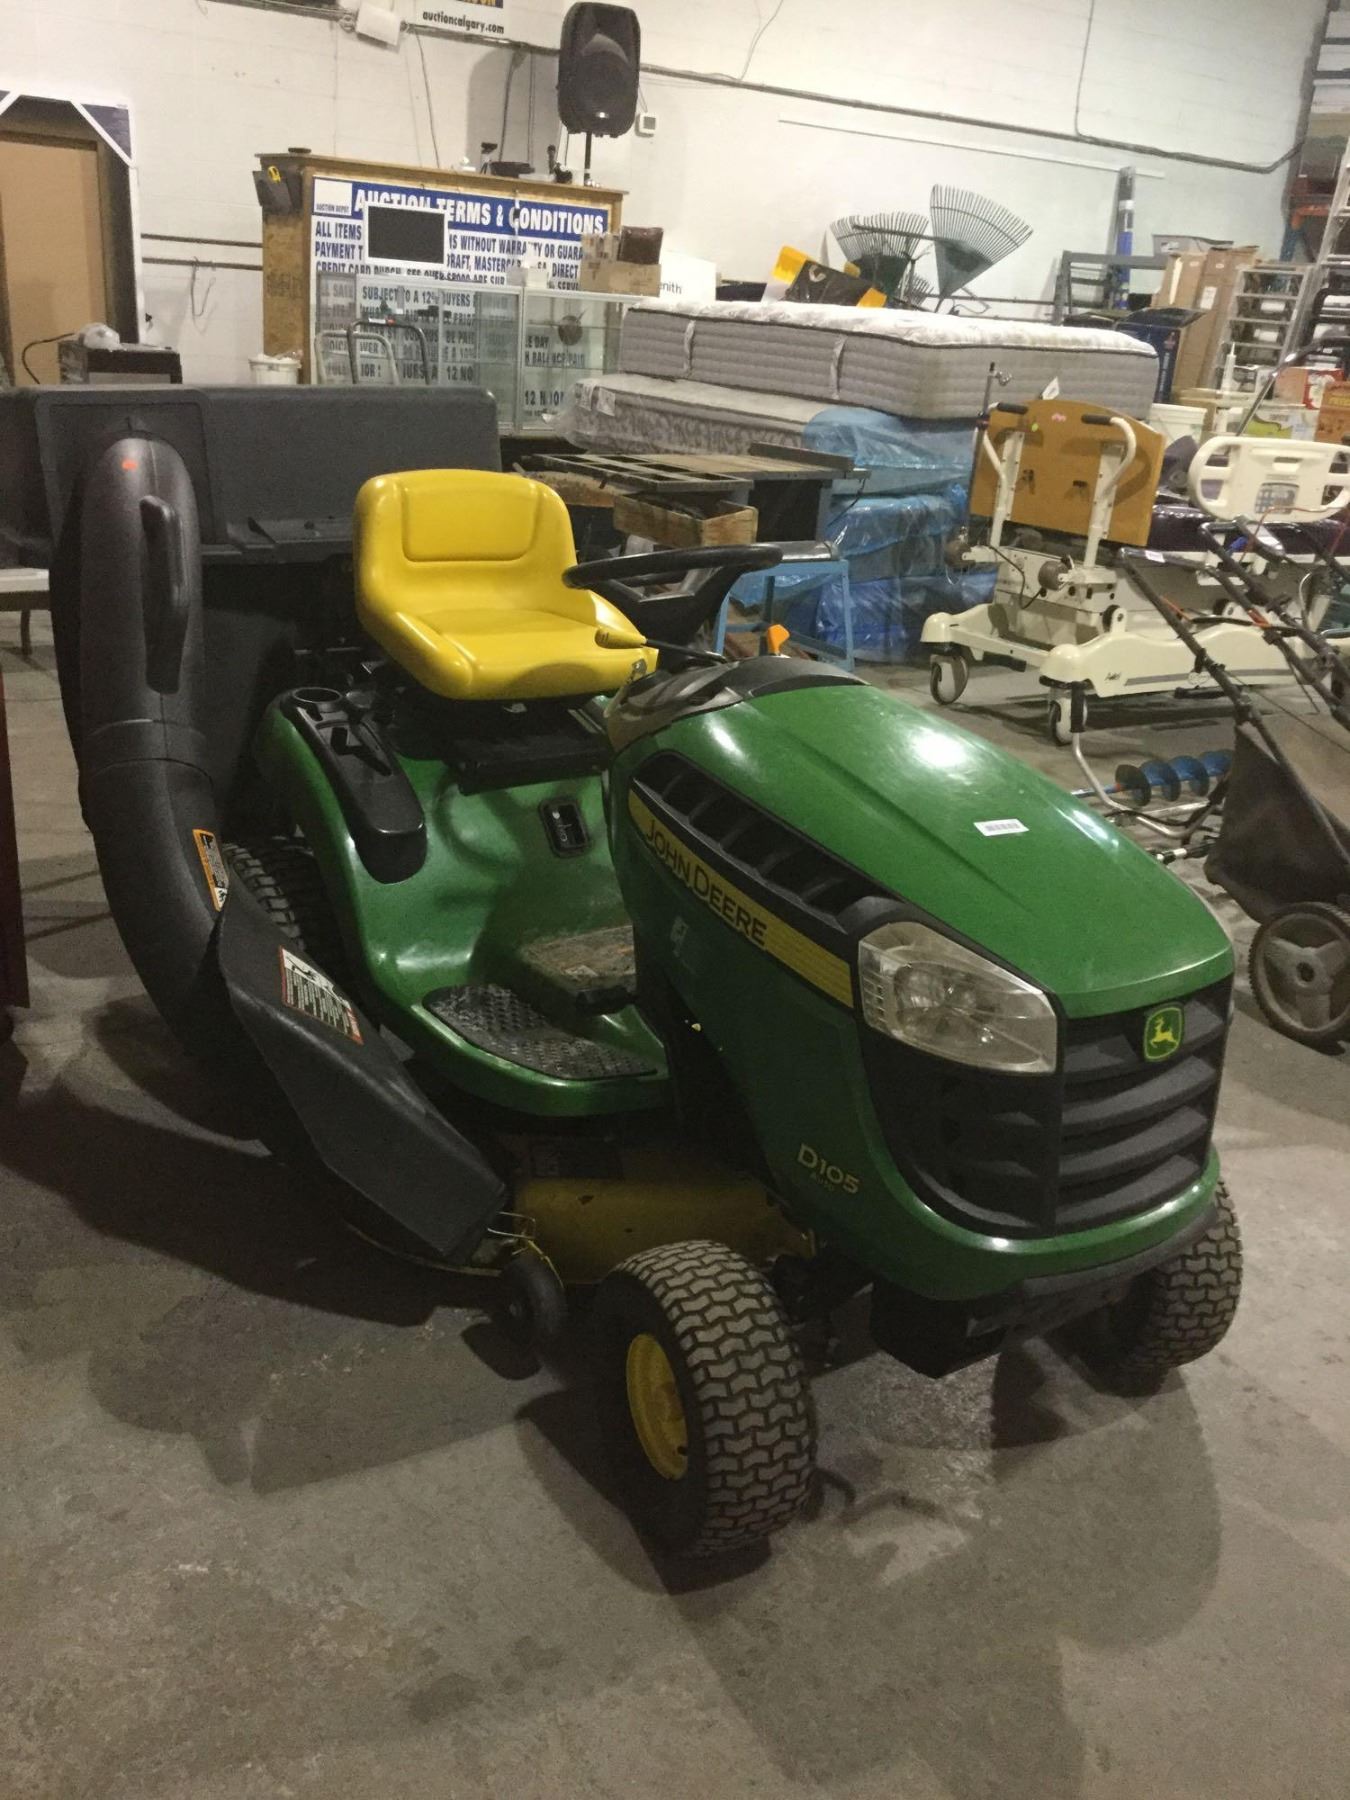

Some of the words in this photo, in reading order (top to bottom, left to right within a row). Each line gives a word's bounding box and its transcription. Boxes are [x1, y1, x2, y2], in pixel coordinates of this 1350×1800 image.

[423, 10, 504, 34] auctioncalgary.com
[436, 198, 492, 226] TERMS
[496, 205, 504, 227] &
[509, 207, 604, 235] CONDITIONS
[315, 221, 332, 238] ALL
[335, 222, 362, 240] ITEMS
[460, 235, 497, 254] WITHOUT
[499, 238, 543, 256] WARRATY
[545, 244, 555, 258] OR
[557, 246, 583, 260] GUARA
[315, 241, 356, 259] PAYMENT
[474, 256, 522, 273] MASTERC
[552, 262, 579, 279] DIRECT
[316, 261, 346, 273] CREDIT
[362, 286, 398, 301] SUBJECT
[525, 390, 536, 405] 12
[646, 818, 691, 886] JOHN
[693, 863, 768, 947] DEERE
[798, 1143, 860, 1194] D105
